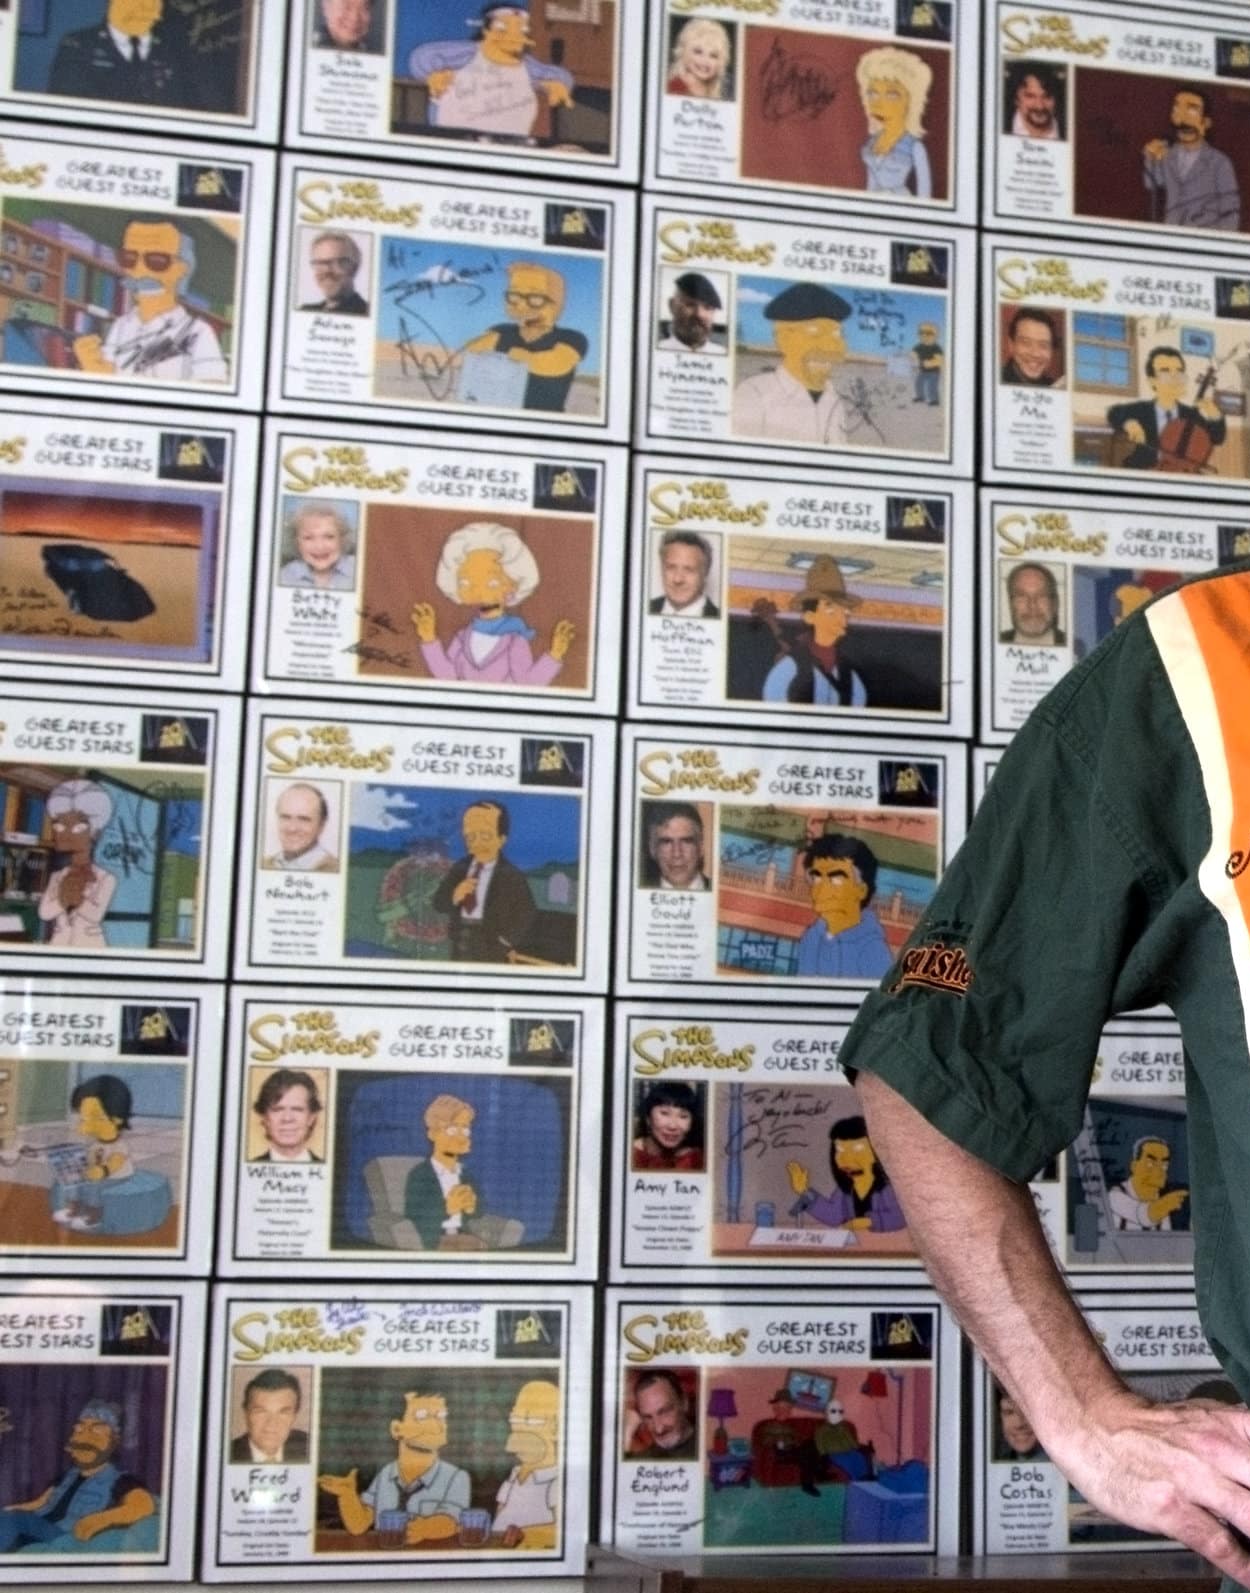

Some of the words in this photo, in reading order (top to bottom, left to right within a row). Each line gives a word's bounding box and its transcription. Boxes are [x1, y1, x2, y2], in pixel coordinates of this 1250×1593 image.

[1122, 32, 1203, 54] GREATEST
[1116, 48, 1165, 67] GUEST
[1170, 54, 1211, 70] STARS
[66, 160, 163, 182] GREATEST
[55, 175, 116, 193] GUEST
[120, 181, 170, 200] STARS
[440, 201, 531, 220] GREATEST
[430, 217, 486, 236] GUEST
[492, 222, 539, 239] STARS
[791, 239, 878, 258] GREATEST
[783, 255, 835, 273] GUEST
[840, 258, 886, 278] STARS
[1122, 276, 1202, 295] GREATEST
[1115, 291, 1164, 309] GUEST
[1169, 295, 1210, 311] STARS
[44, 432, 144, 452] GREATEST
[34, 451, 95, 467] GUEST
[102, 455, 153, 473] STARS
[427, 464, 520, 483] GREATEST
[417, 483, 474, 497] GUEST
[480, 486, 528, 502] STARS
[786, 498, 874, 517] GREATEST
[776, 514, 832, 529] GUEST
[837, 518, 882, 535] STARS
[1124, 528, 1205, 545] GREATEST
[1115, 544, 1165, 560] GUEST
[1170, 547, 1214, 562] STARS
[661, 618, 705, 633] Dustin
[651, 632, 715, 647] Hoffman
[1007, 648, 1059, 663] Martin
[1016, 661, 1050, 675] Mull
[25, 717, 126, 735] GREATEST
[14, 733, 76, 750] GUEST
[82, 737, 134, 755] STARS
[412, 741, 506, 760] GREATEST
[676, 749, 720, 768] THE
[402, 759, 460, 775] GUEST
[466, 761, 515, 778] STARS
[776, 763, 867, 782] GREATEST
[768, 780, 822, 796] GUEST
[827, 783, 874, 799] STARS
[284, 875, 314, 889] Bob
[265, 888, 331, 902] Newhart
[650, 893, 696, 906] Elliott
[651, 907, 692, 921] Gould
[292, 1011, 335, 1030] THE
[61, 1032, 114, 1048] STARS
[400, 1025, 493, 1042] GREATEST
[671, 1027, 713, 1045] THE
[389, 1042, 446, 1058] GUEST
[453, 1042, 504, 1060] STARS
[772, 1039, 840, 1053] GREATE
[764, 1058, 818, 1071] GUEST
[1118, 1052, 1182, 1065] GREATE
[1111, 1068, 1161, 1082] GUEST
[247, 1167, 303, 1180] William
[261, 1180, 307, 1196] Macy
[634, 1179, 667, 1196] Amy
[673, 1180, 700, 1194] Tan
[0, 1313, 86, 1331] REATEST
[273, 1308, 321, 1329] THE
[383, 1318, 481, 1335] GREATEST
[663, 1310, 708, 1331] THE
[766, 1322, 858, 1337] GREATEST
[39, 1334, 96, 1349] STARS
[373, 1337, 436, 1353] GUEST
[440, 1338, 490, 1353] STARS
[757, 1339, 815, 1354] GUEST
[818, 1339, 866, 1354] STARS
[1114, 1342, 1163, 1355] GUEST
[248, 1468, 289, 1485] Fred
[637, 1466, 685, 1480] Robert
[1011, 1467, 1044, 1482] Bob
[631, 1480, 689, 1496] Englund
[1000, 1484, 1052, 1500] Costas
